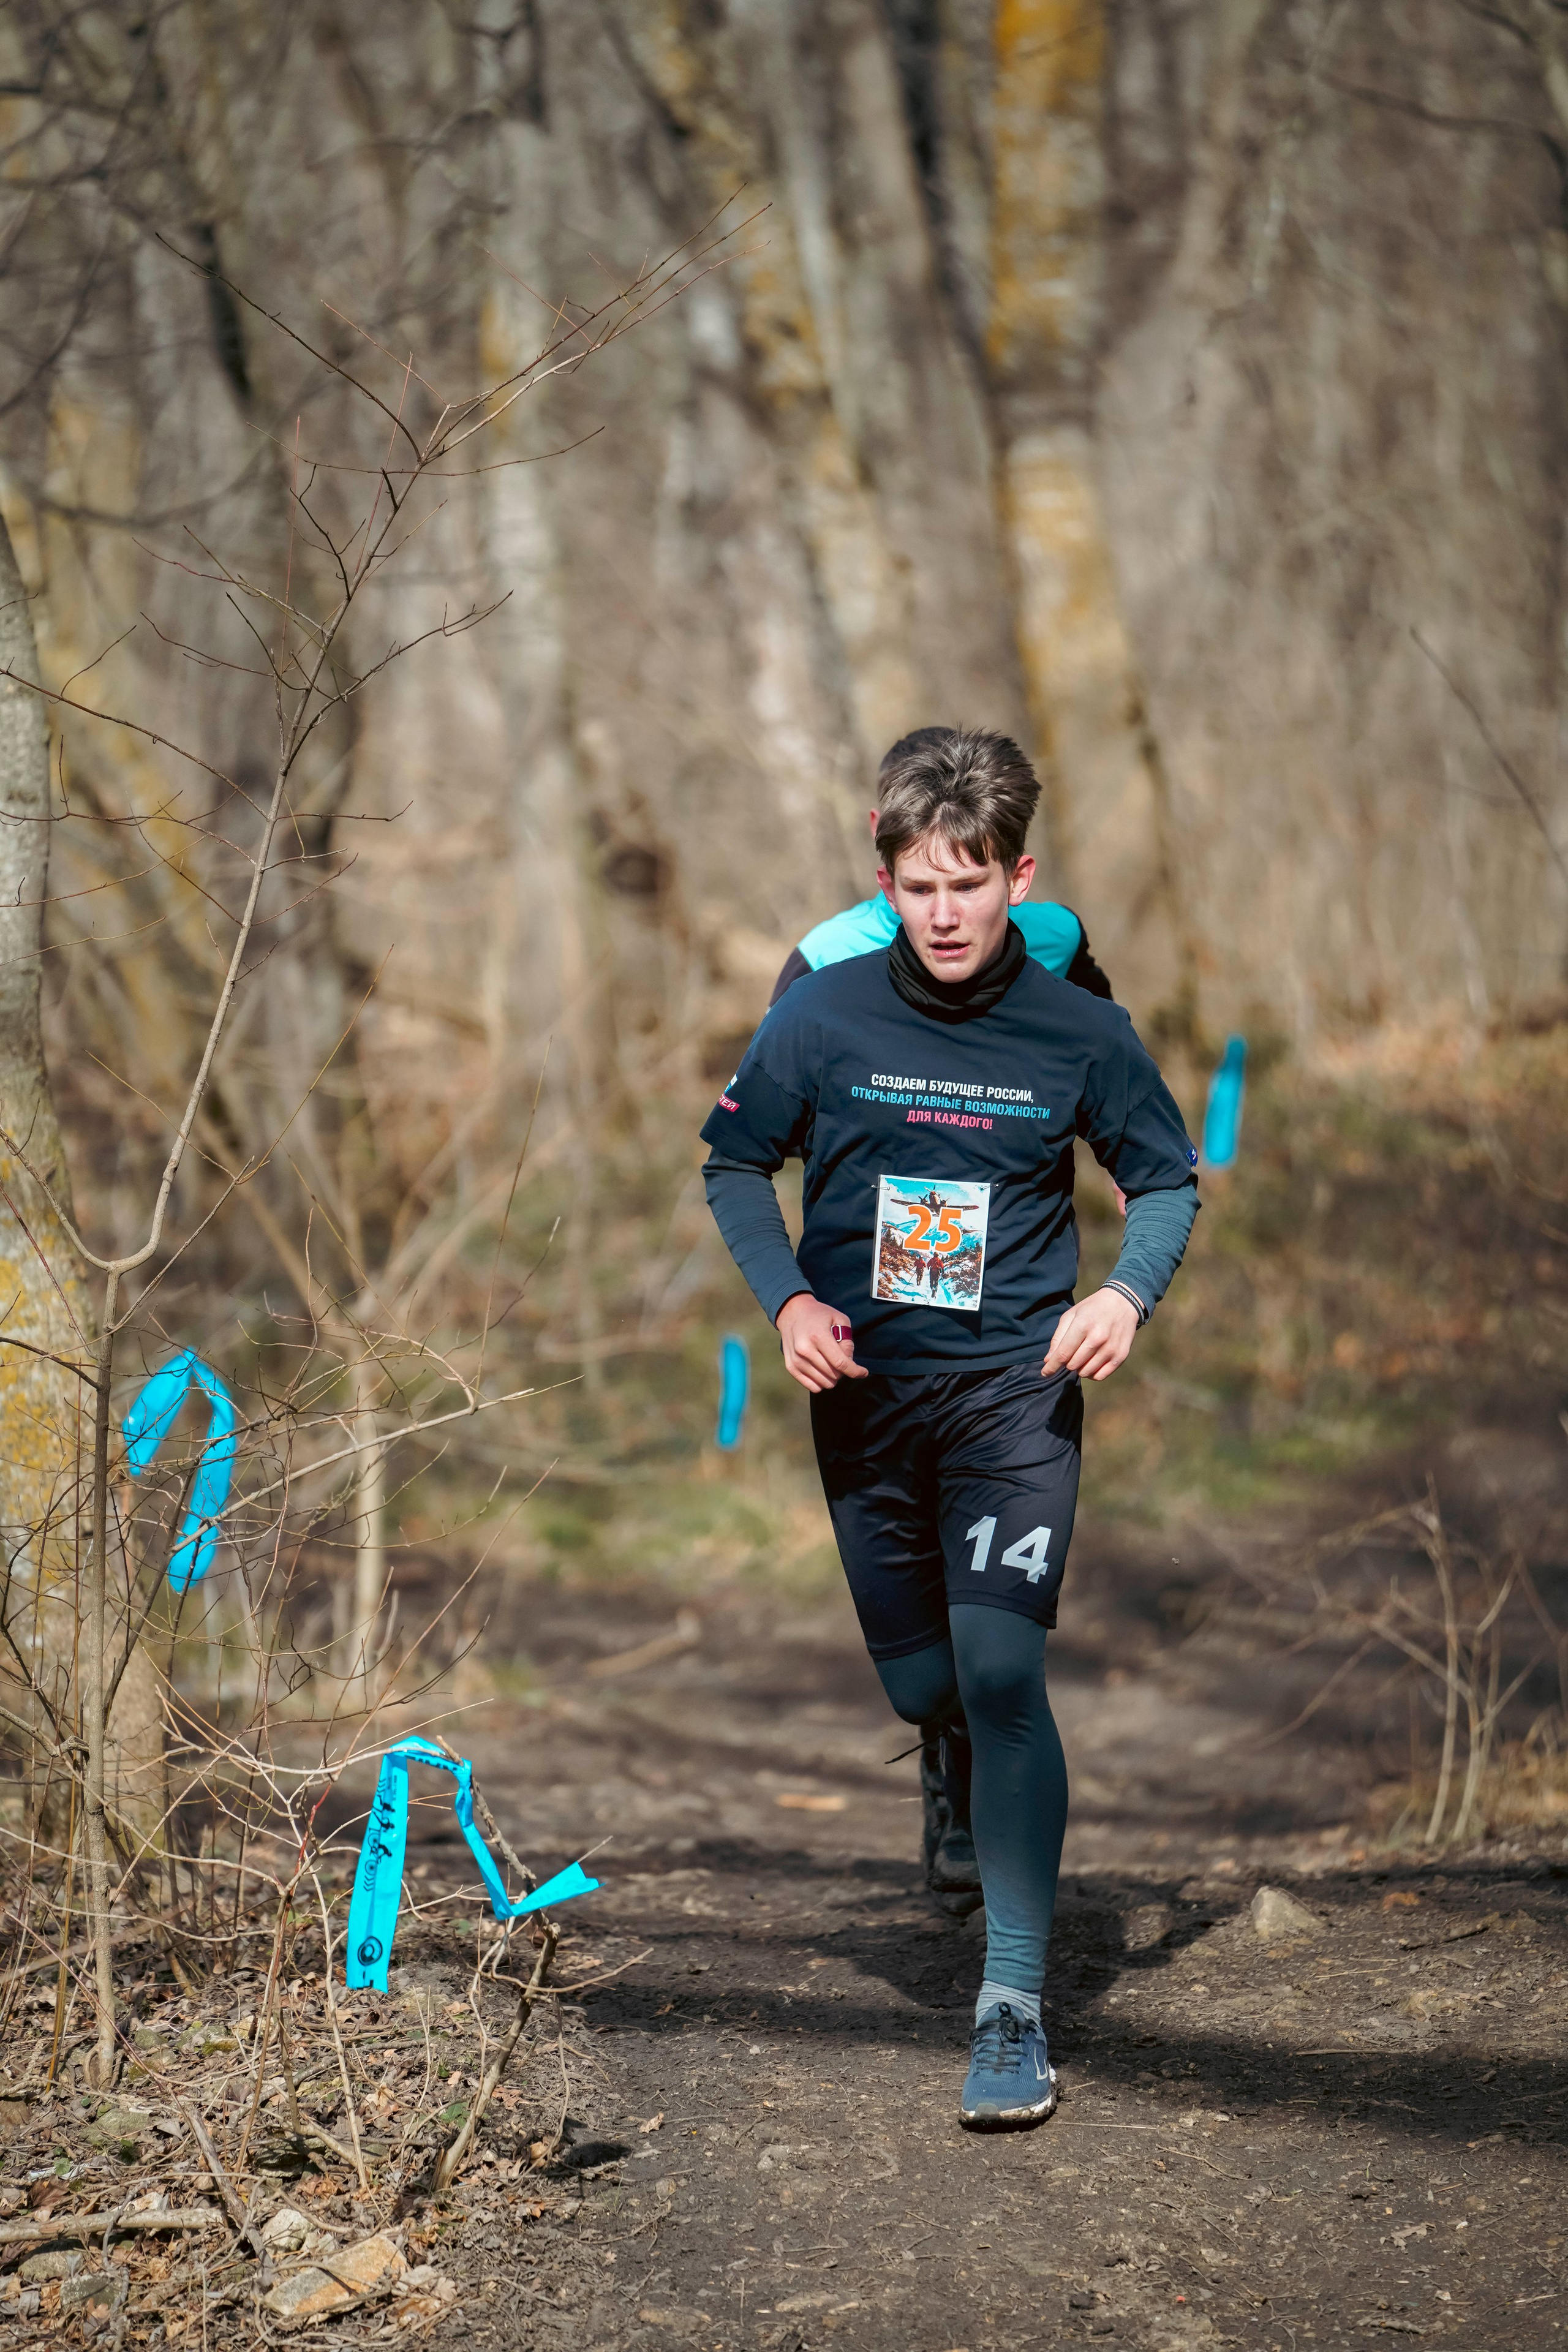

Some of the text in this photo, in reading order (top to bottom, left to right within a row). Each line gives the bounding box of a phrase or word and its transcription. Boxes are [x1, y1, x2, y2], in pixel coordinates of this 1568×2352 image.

[719, 1093, 737, 1110] ТЕЙ
[851, 1086, 1050, 1120] ОТКРЫВАЯ РАВНЫЕ ВОЗМОЖНОСТИ
[871, 1074, 1034, 1104] СОЗДАЕМ БУДУЩЕЕ РОССИИ,
[907, 1110, 993, 1130] ДЛЯ КАЖДОГО!
[903, 1204, 963, 1253] 25
[965, 1515, 1052, 1584] 14
